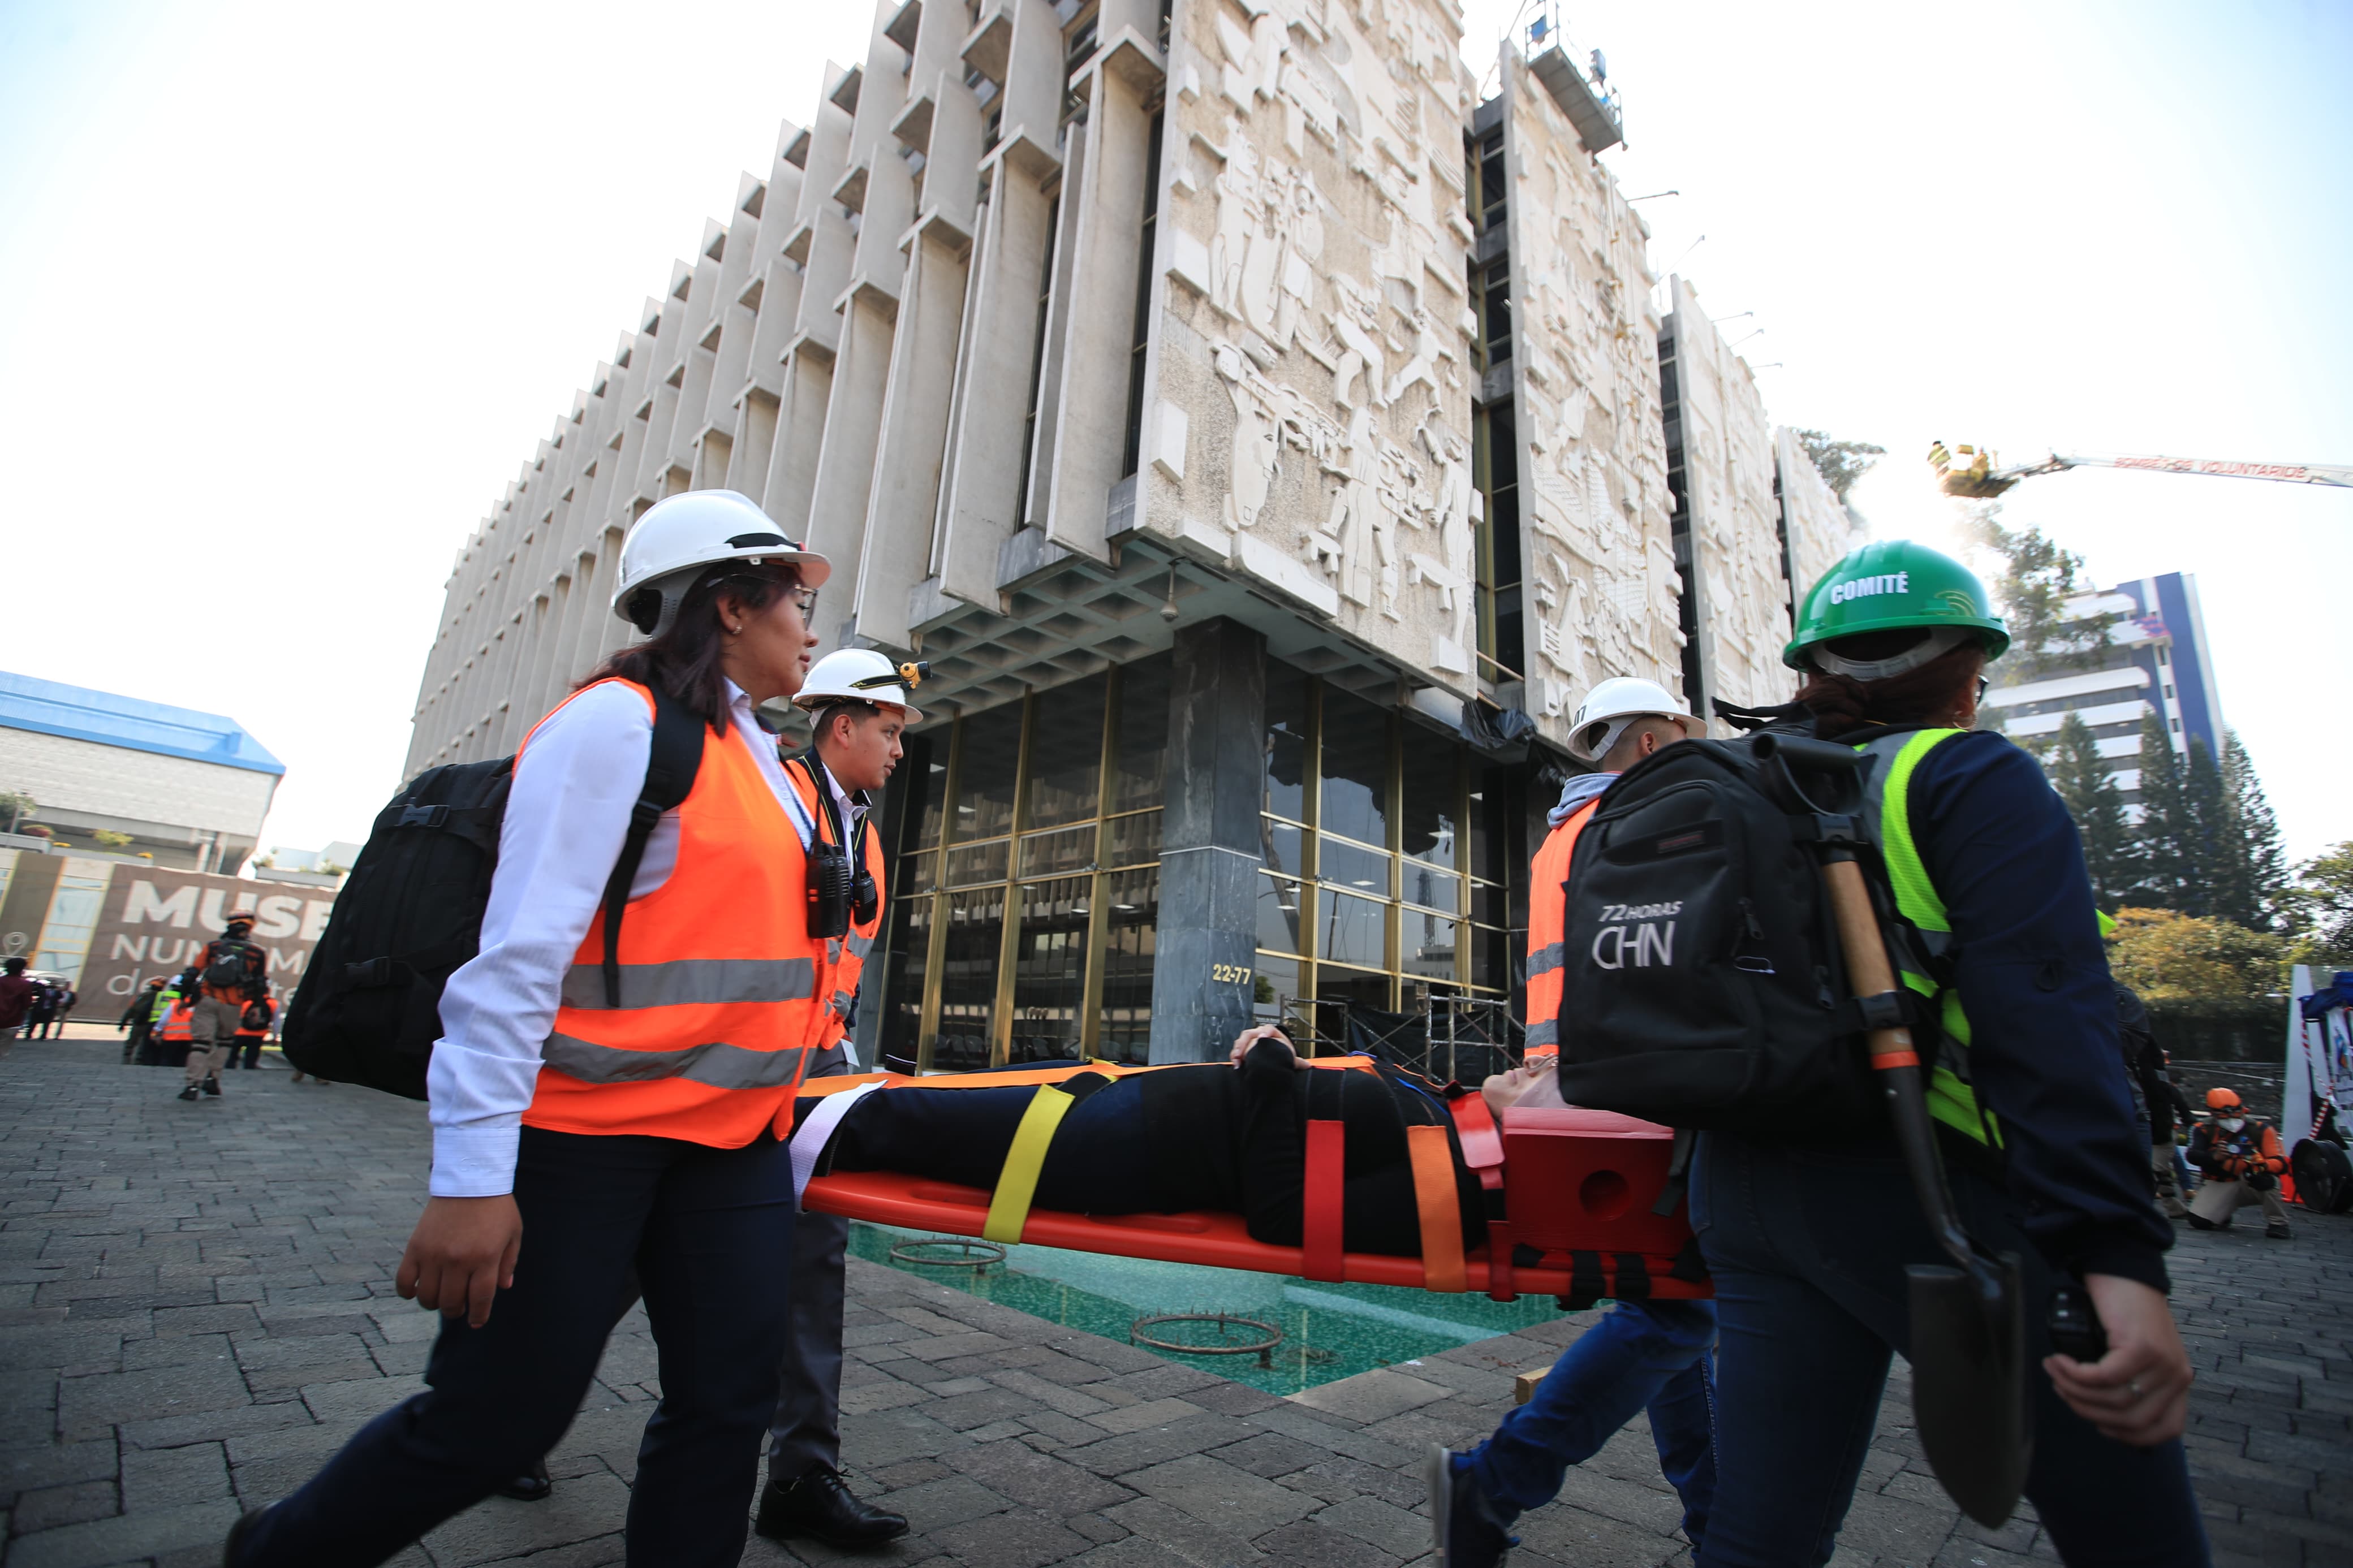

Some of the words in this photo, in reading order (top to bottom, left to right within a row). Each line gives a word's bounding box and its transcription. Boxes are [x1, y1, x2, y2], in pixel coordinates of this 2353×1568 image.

[1830, 571, 1909, 604] COMITÉ
[1592, 921, 1676, 970] CHN
[1212, 964, 1251, 984] 22-77
